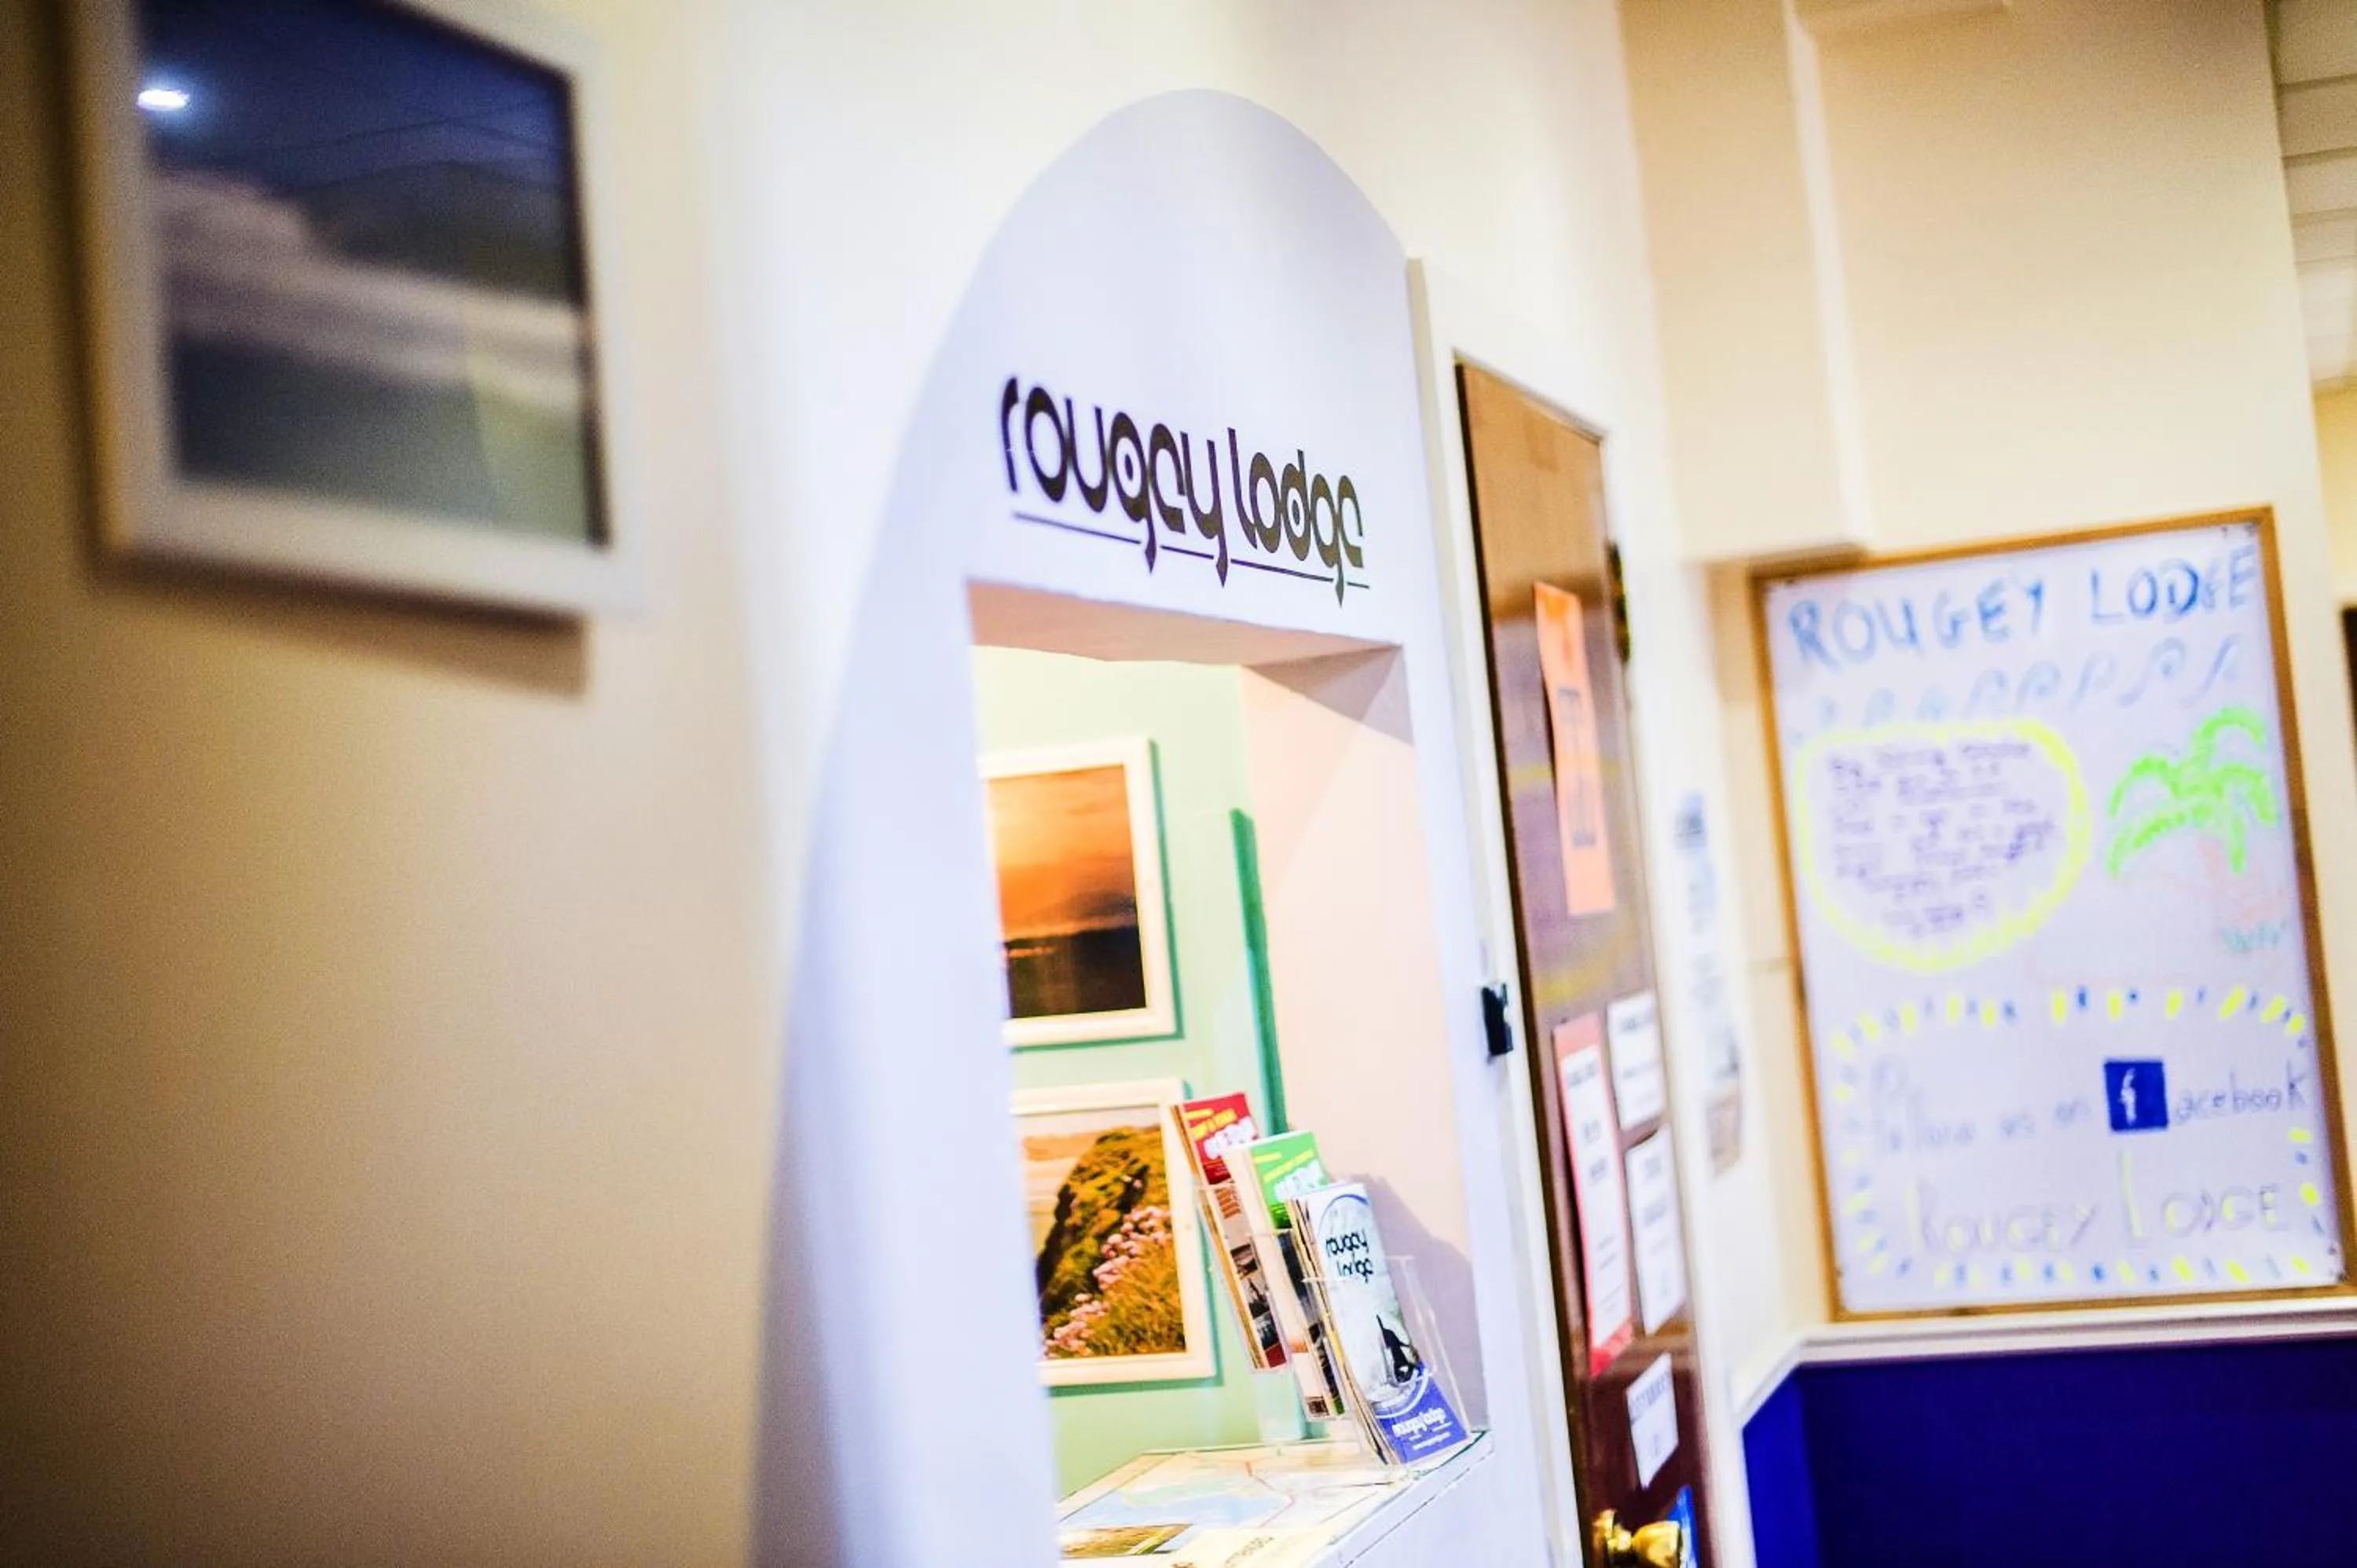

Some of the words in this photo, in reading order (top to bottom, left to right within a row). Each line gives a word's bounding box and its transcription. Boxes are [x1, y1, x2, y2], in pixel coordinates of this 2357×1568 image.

[1002, 376, 1229, 588] rougey
[1227, 427, 1364, 608] lodge
[1787, 576, 2047, 673] ROUGEY
